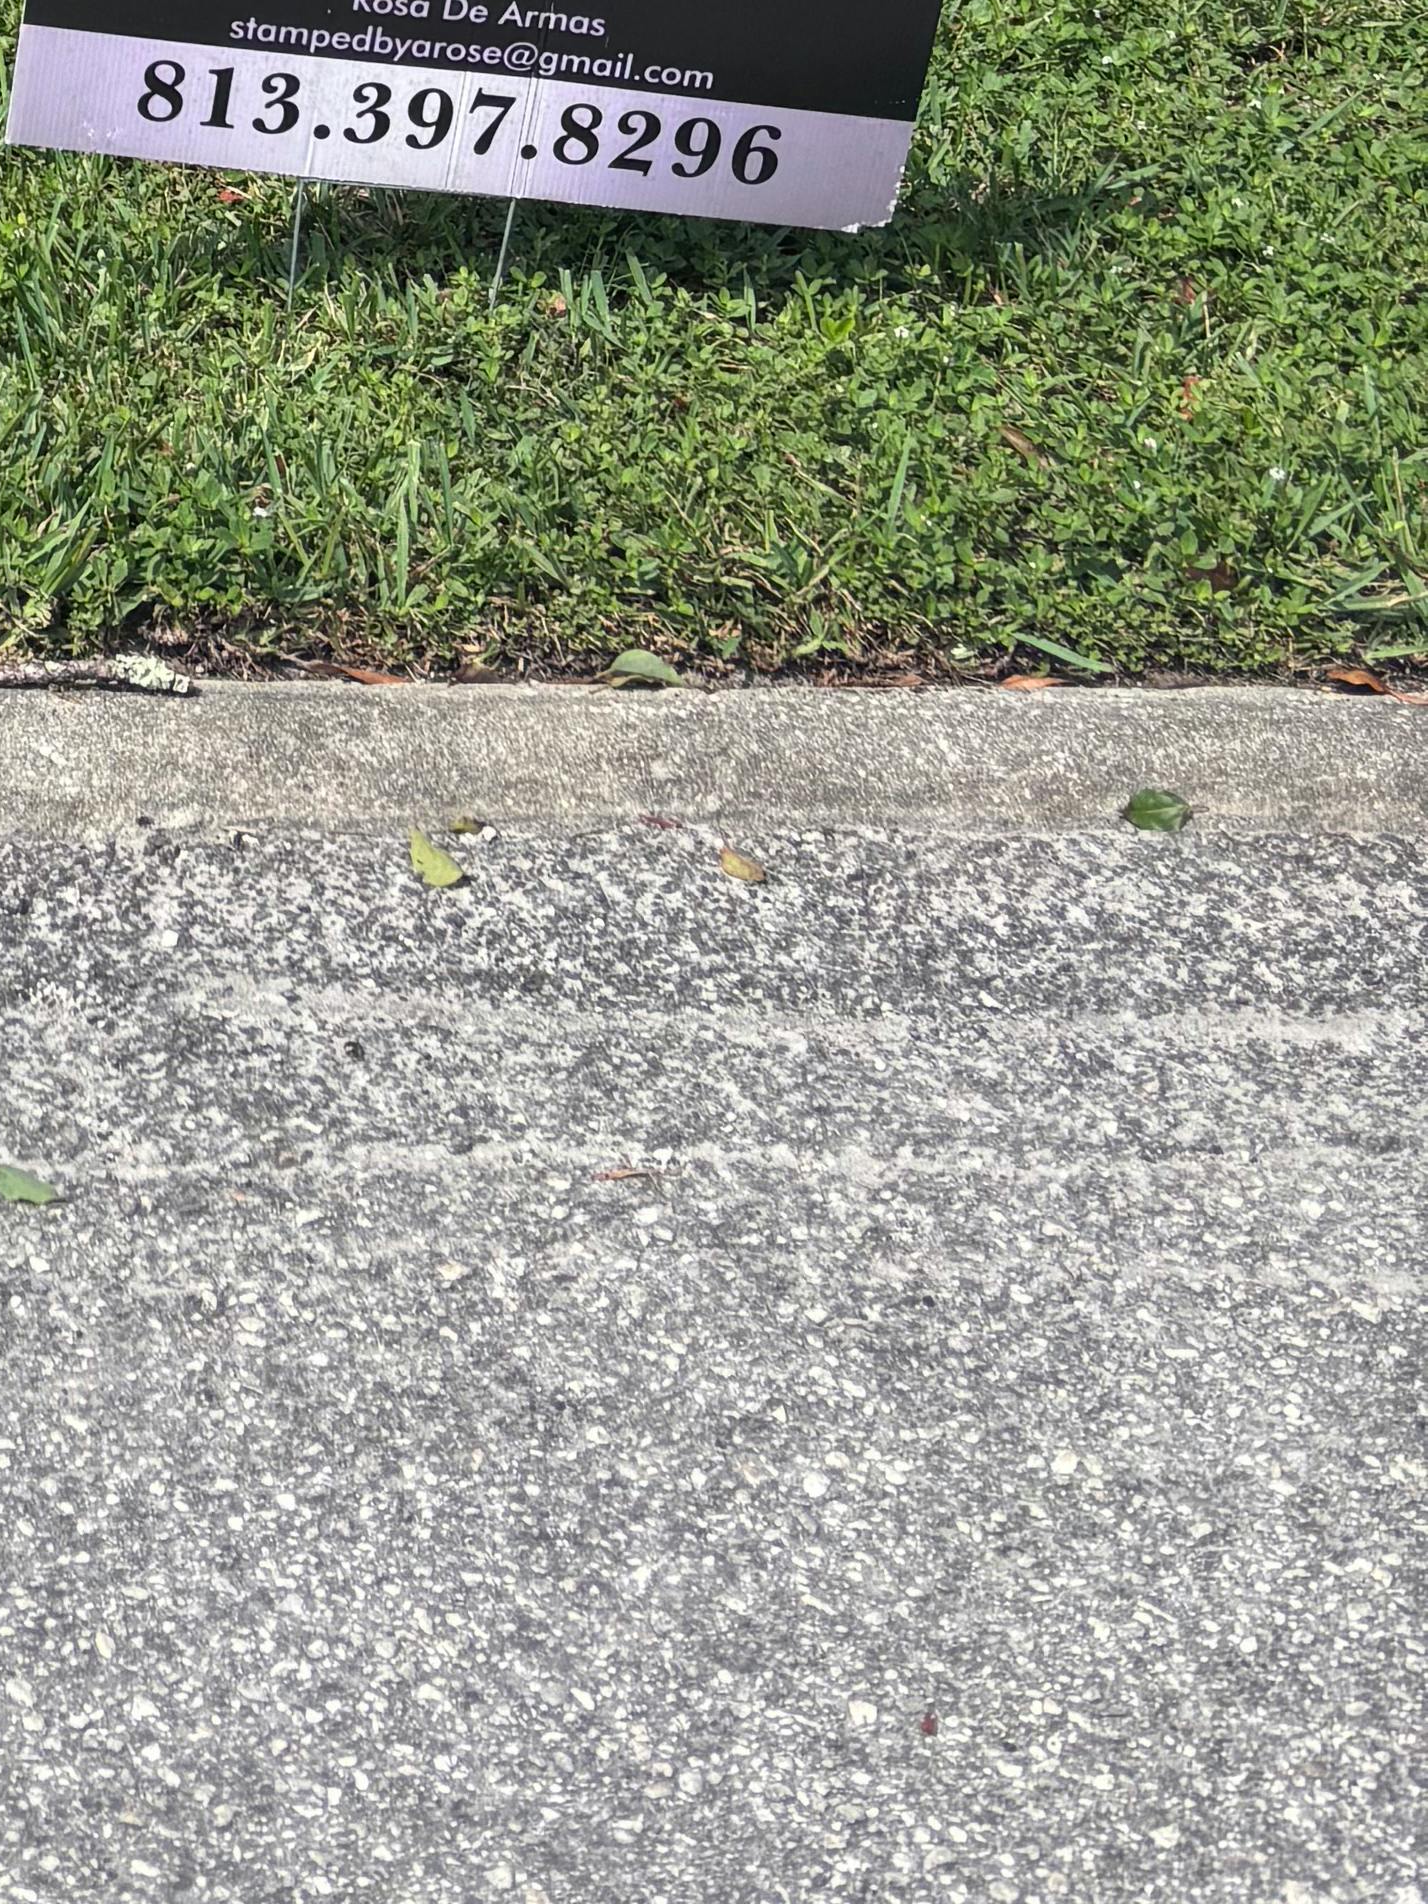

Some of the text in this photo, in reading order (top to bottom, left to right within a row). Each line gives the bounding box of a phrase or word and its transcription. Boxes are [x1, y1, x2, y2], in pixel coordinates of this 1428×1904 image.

[229, 17, 714, 90] stampedbyarose@gmail.com
[497, 0, 605, 37] Armas
[137, 59, 782, 185] 813.397.8296
